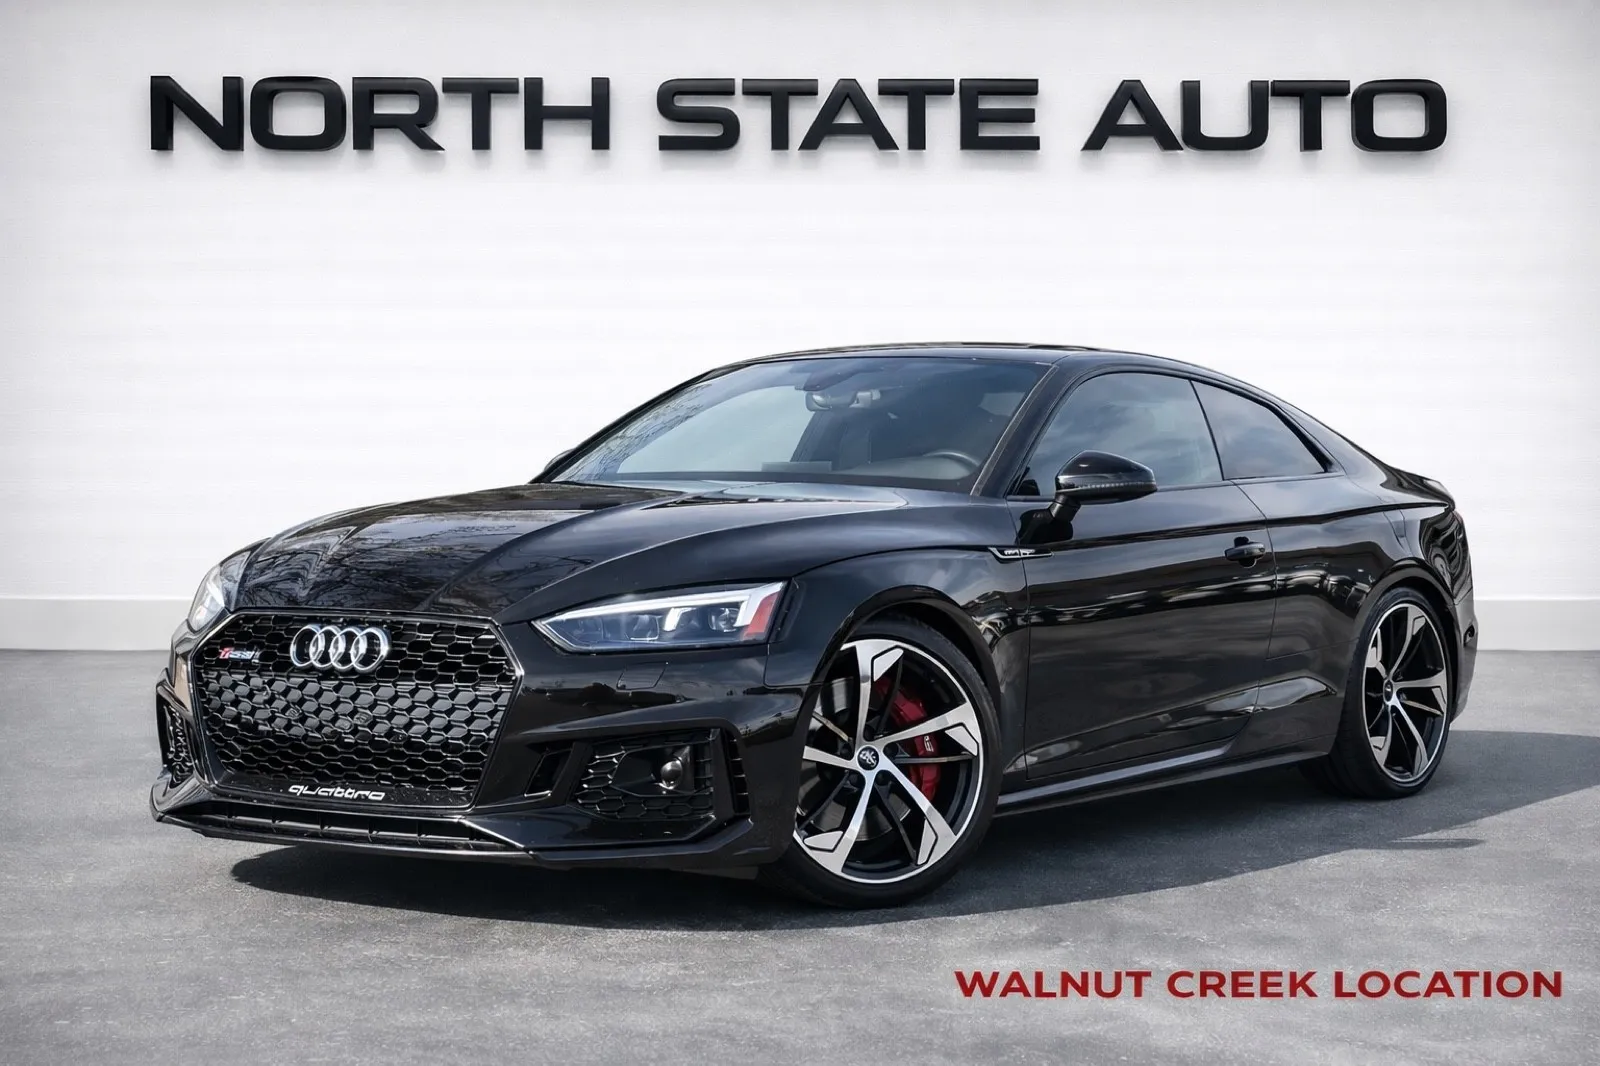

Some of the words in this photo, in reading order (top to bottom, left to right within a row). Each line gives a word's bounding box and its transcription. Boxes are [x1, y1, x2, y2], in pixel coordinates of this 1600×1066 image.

[150, 75, 610, 152] NORTH
[657, 77, 1041, 152] STATE
[1081, 78, 1448, 153] AUTO
[288, 784, 386, 801] quattro
